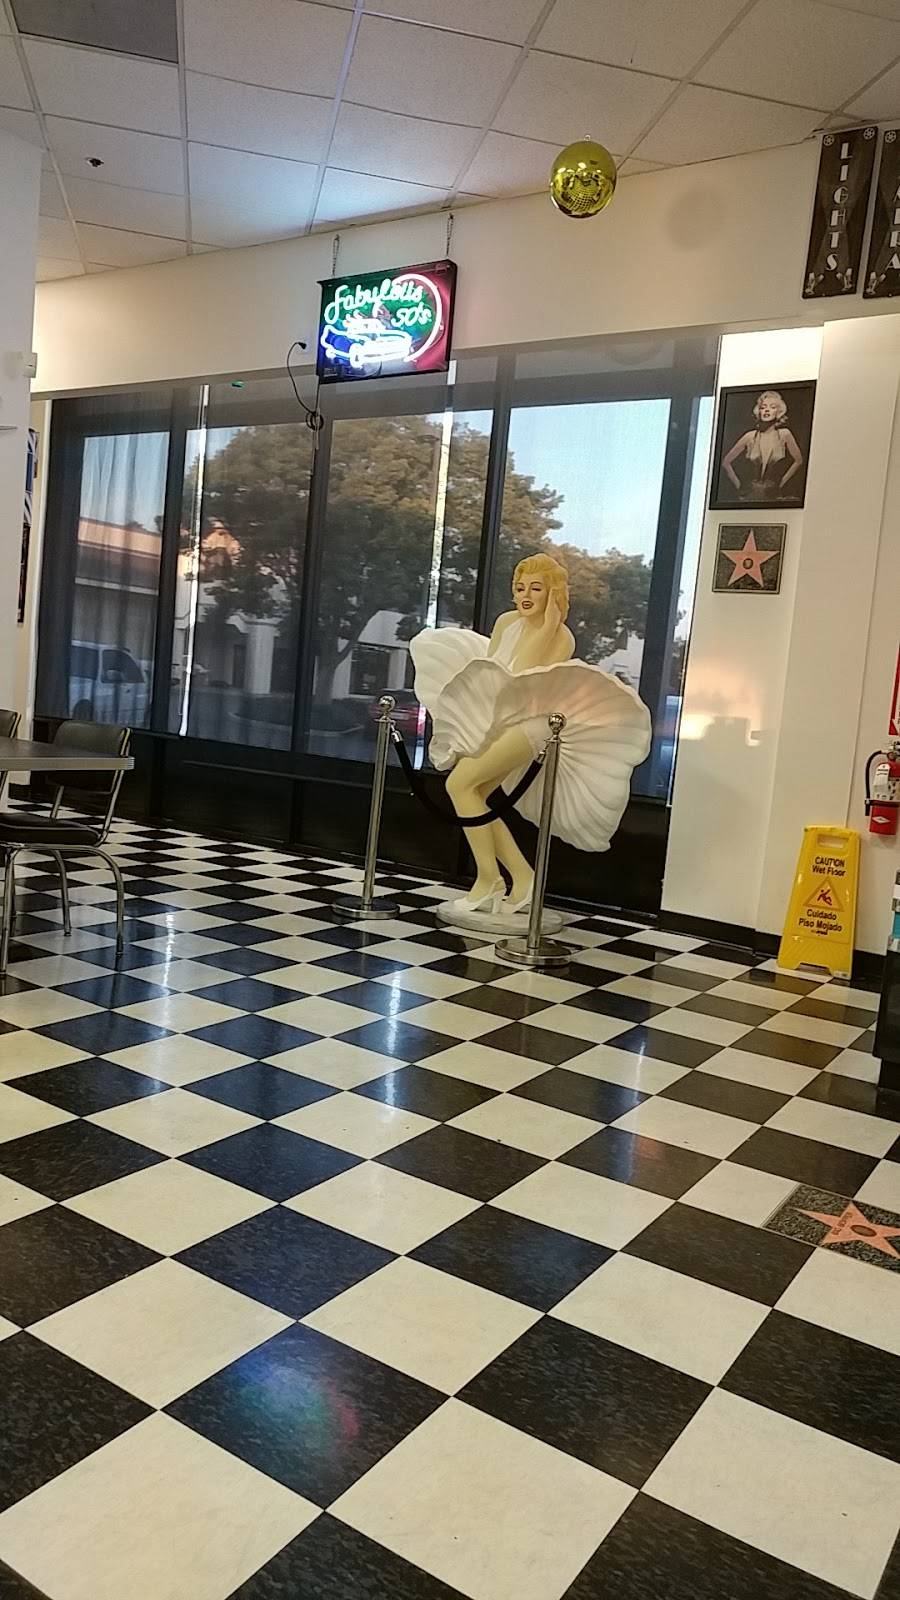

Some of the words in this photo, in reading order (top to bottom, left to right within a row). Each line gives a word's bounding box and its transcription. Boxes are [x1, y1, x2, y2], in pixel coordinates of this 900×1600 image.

[825, 142, 852, 270] LIGHTS
[391, 302, 432, 327] 50's
[815, 857, 845, 867] CAUTION
[812, 864, 826, 874] Wet
[827, 867, 846, 876] Floor
[806, 909, 836, 920] Cuidado
[799, 918, 814, 927] Piso
[817, 920, 842, 932] Mojado
